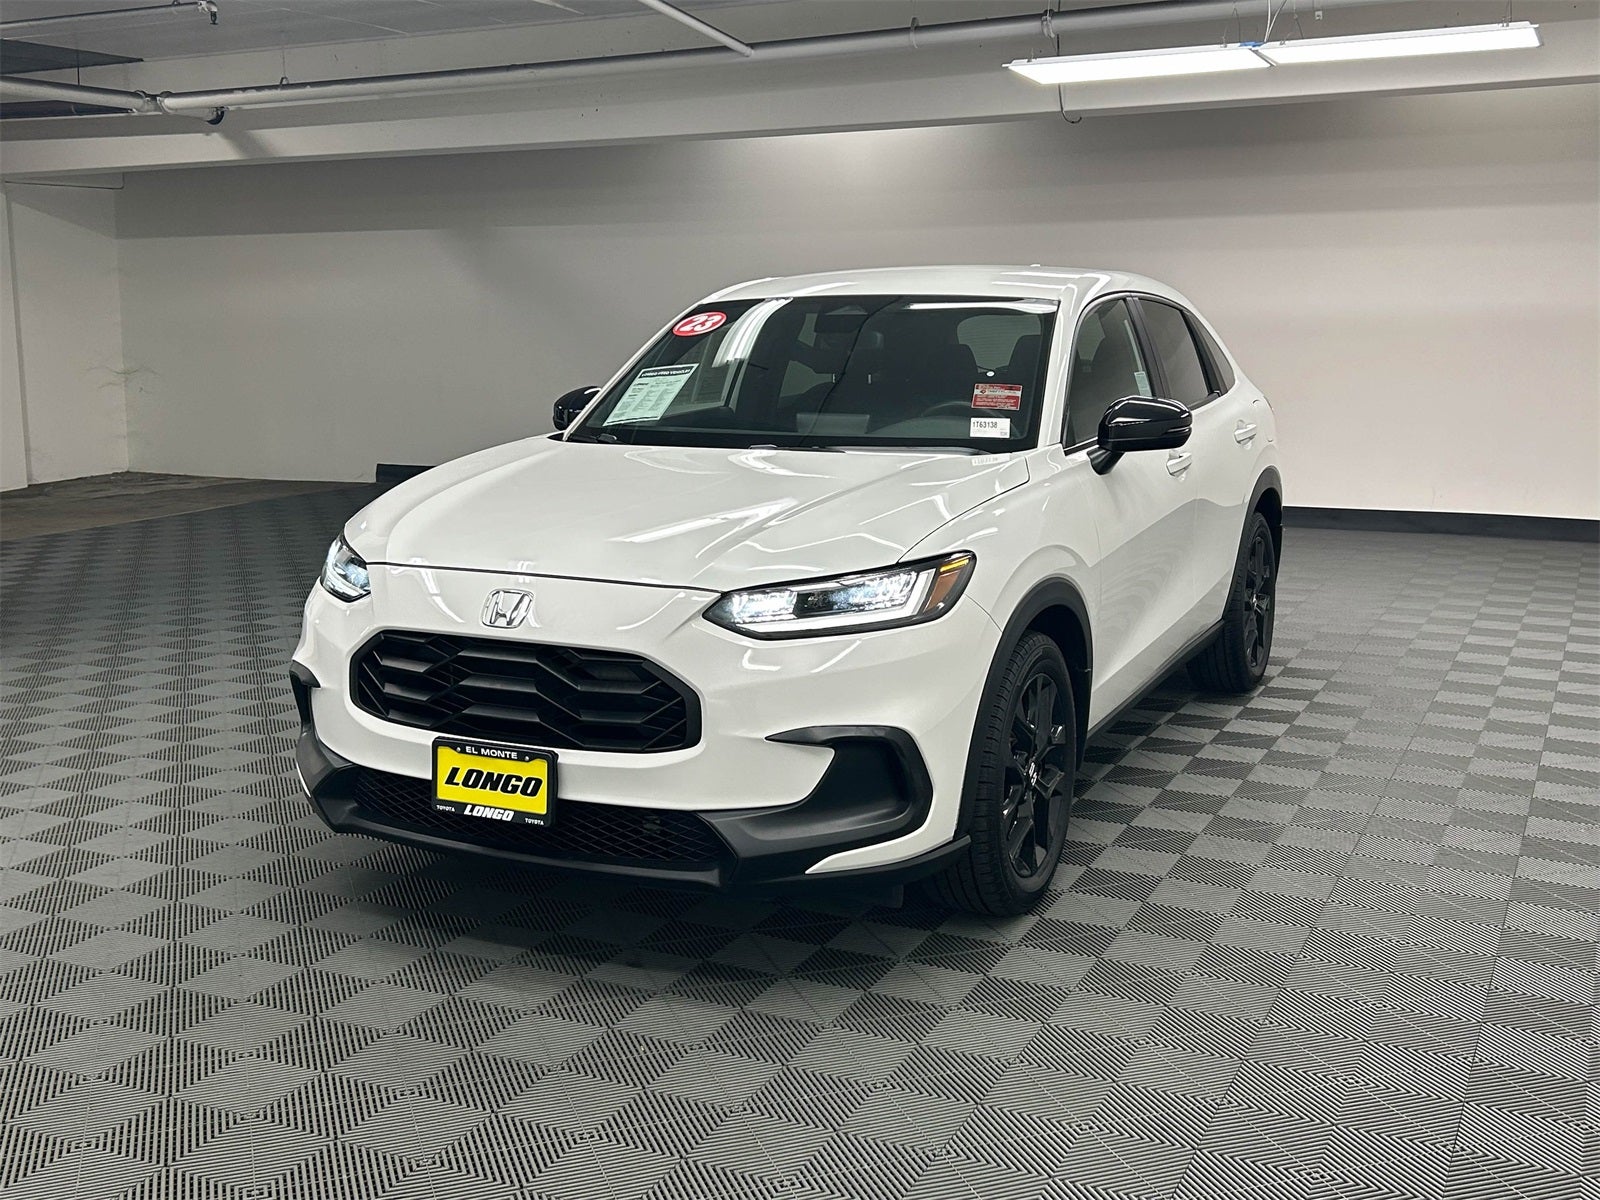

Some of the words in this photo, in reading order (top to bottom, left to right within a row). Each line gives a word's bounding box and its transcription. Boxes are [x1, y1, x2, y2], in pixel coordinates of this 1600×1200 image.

[677, 314, 722, 332] 23
[972, 421, 998, 429] 1T63138
[465, 746, 478, 754] EL
[481, 748, 518, 759] MONTE
[444, 766, 543, 797] LONGO
[436, 804, 455, 812] TOYOTA
[463, 804, 515, 822] LONGO
[525, 817, 545, 826] TOYOTA
